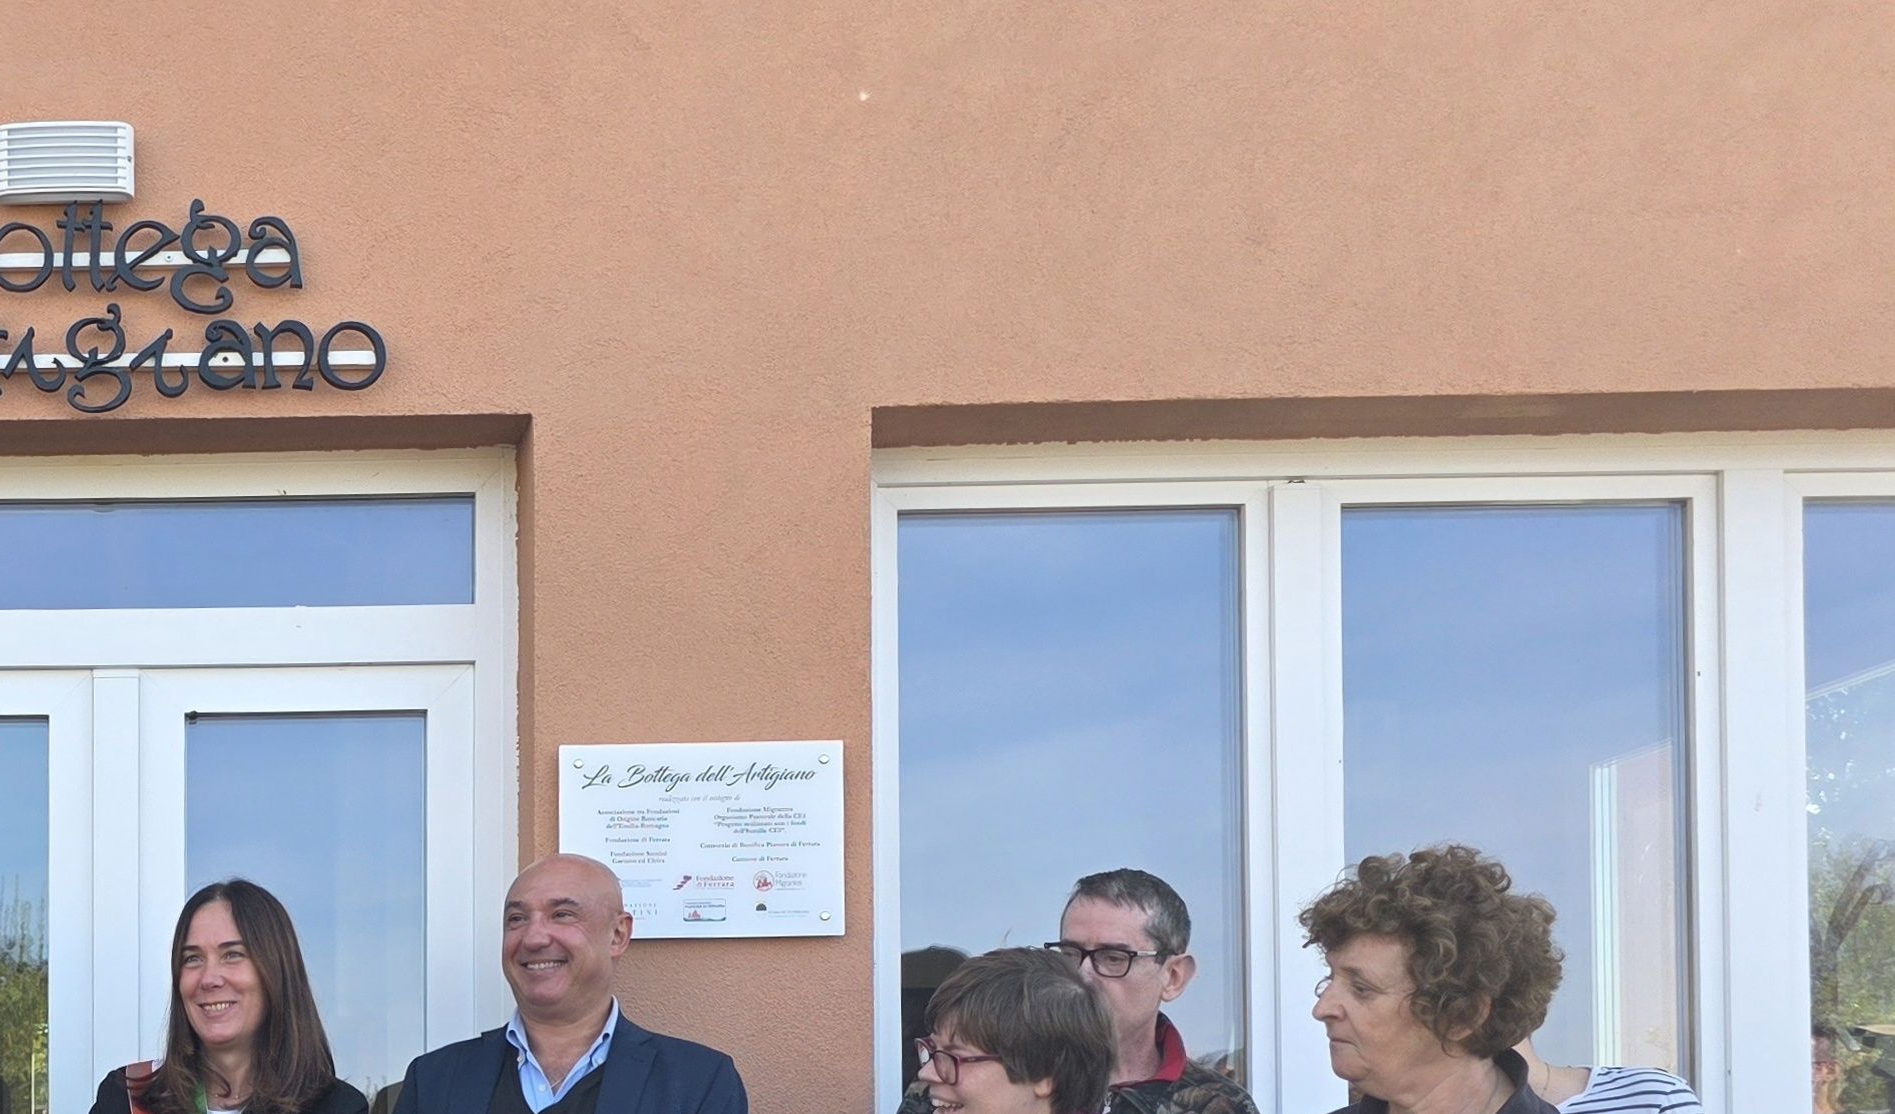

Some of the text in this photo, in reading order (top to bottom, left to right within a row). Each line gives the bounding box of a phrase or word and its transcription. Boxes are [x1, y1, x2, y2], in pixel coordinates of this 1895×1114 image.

[582, 762, 816, 792] La Bottega dell'Artigiano
